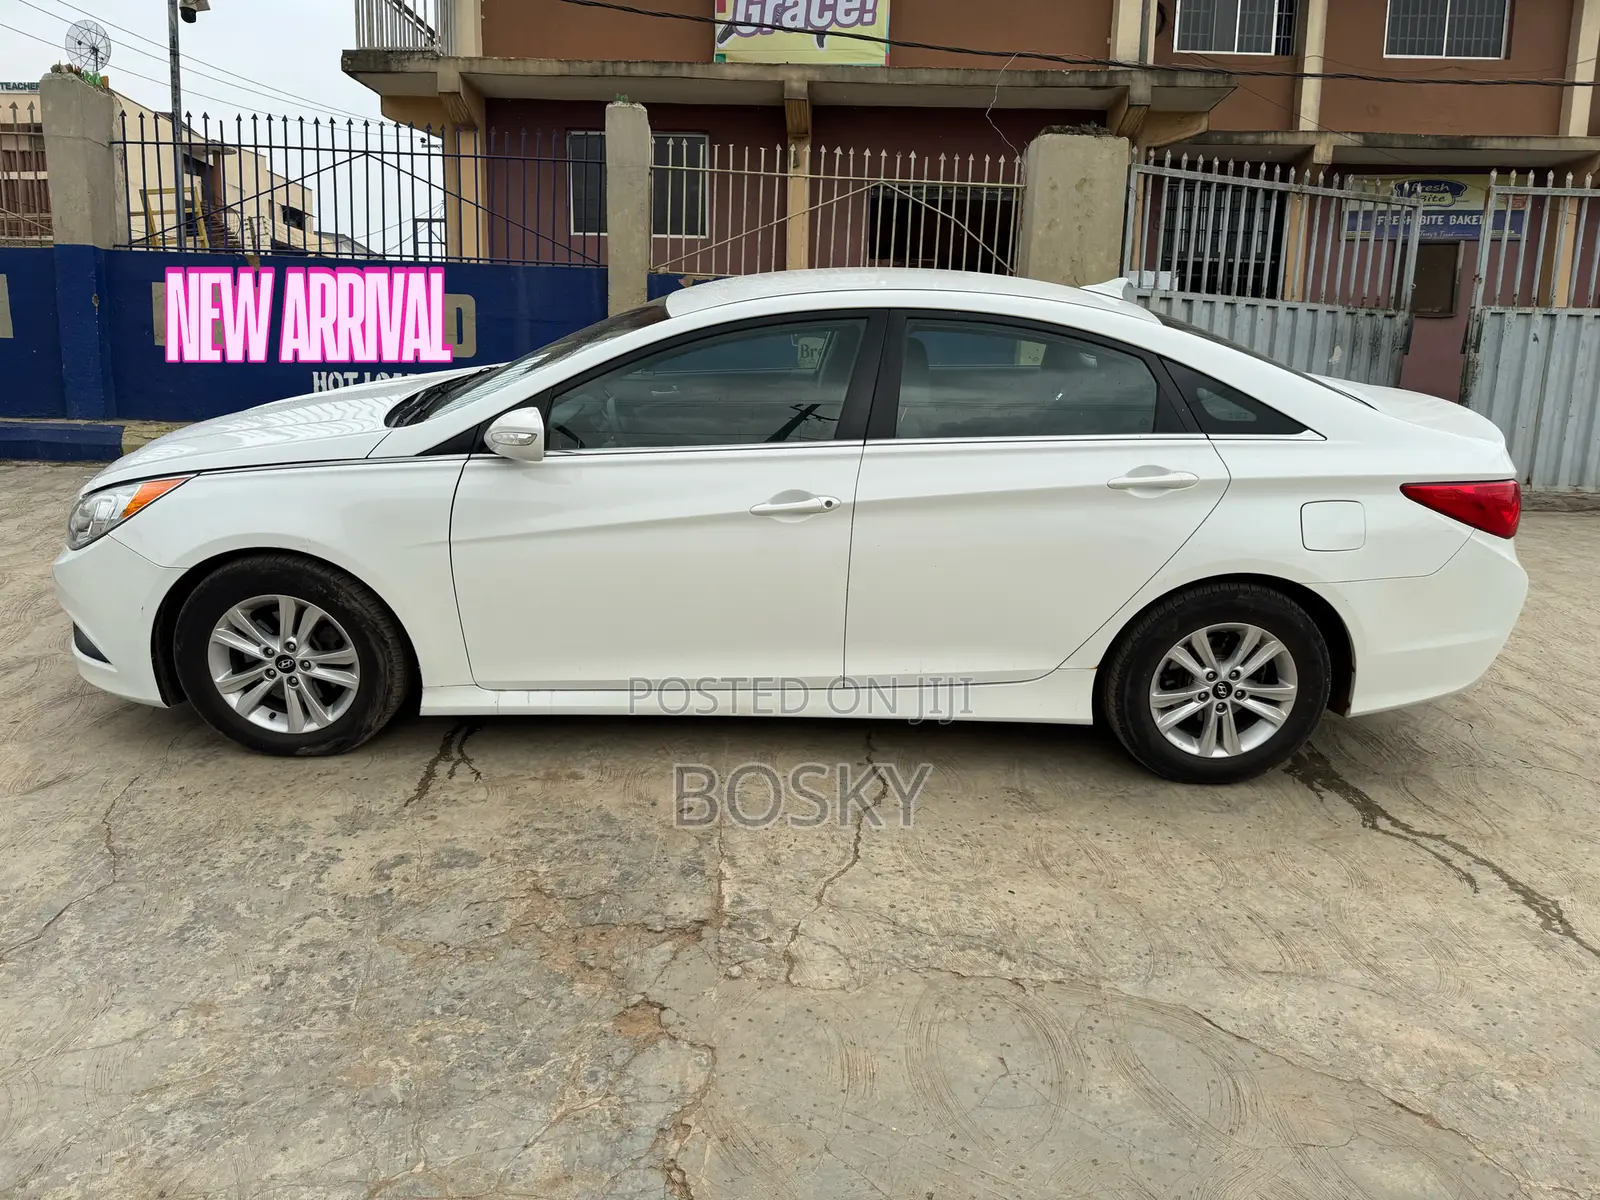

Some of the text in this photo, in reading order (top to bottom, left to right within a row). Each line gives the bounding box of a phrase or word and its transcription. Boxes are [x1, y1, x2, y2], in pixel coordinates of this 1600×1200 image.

[733, 0, 877, 37] Grace!
[1420, 214, 1445, 225] BITE
[312, 371, 359, 393] HOT
